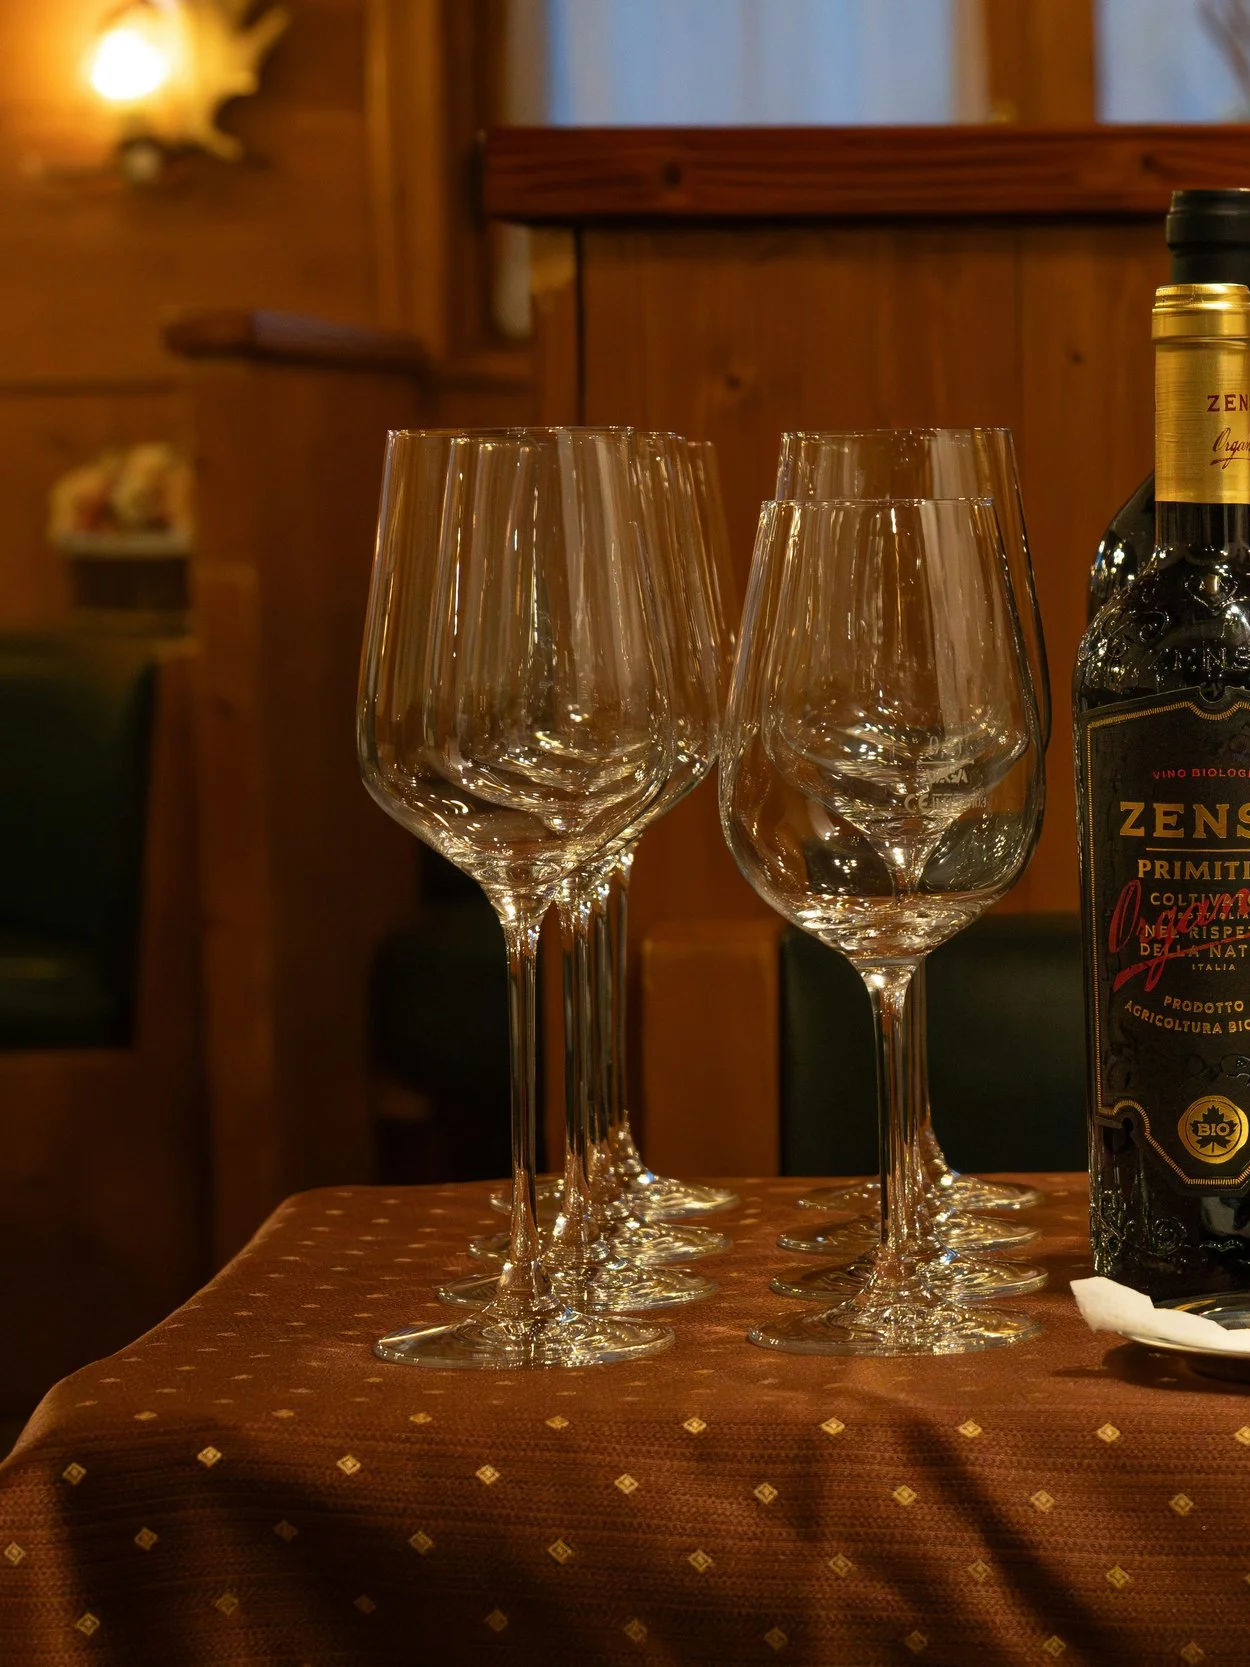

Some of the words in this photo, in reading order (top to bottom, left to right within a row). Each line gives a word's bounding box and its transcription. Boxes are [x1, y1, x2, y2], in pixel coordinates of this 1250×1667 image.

[1152, 769, 1186, 779] VINO
[1191, 963, 1236, 971] ITALIA
[1163, 995, 1245, 1014] PRODOTTO
[1124, 1000, 1223, 1034] AGRICOLTURA
[1197, 1123, 1230, 1136] BIO
